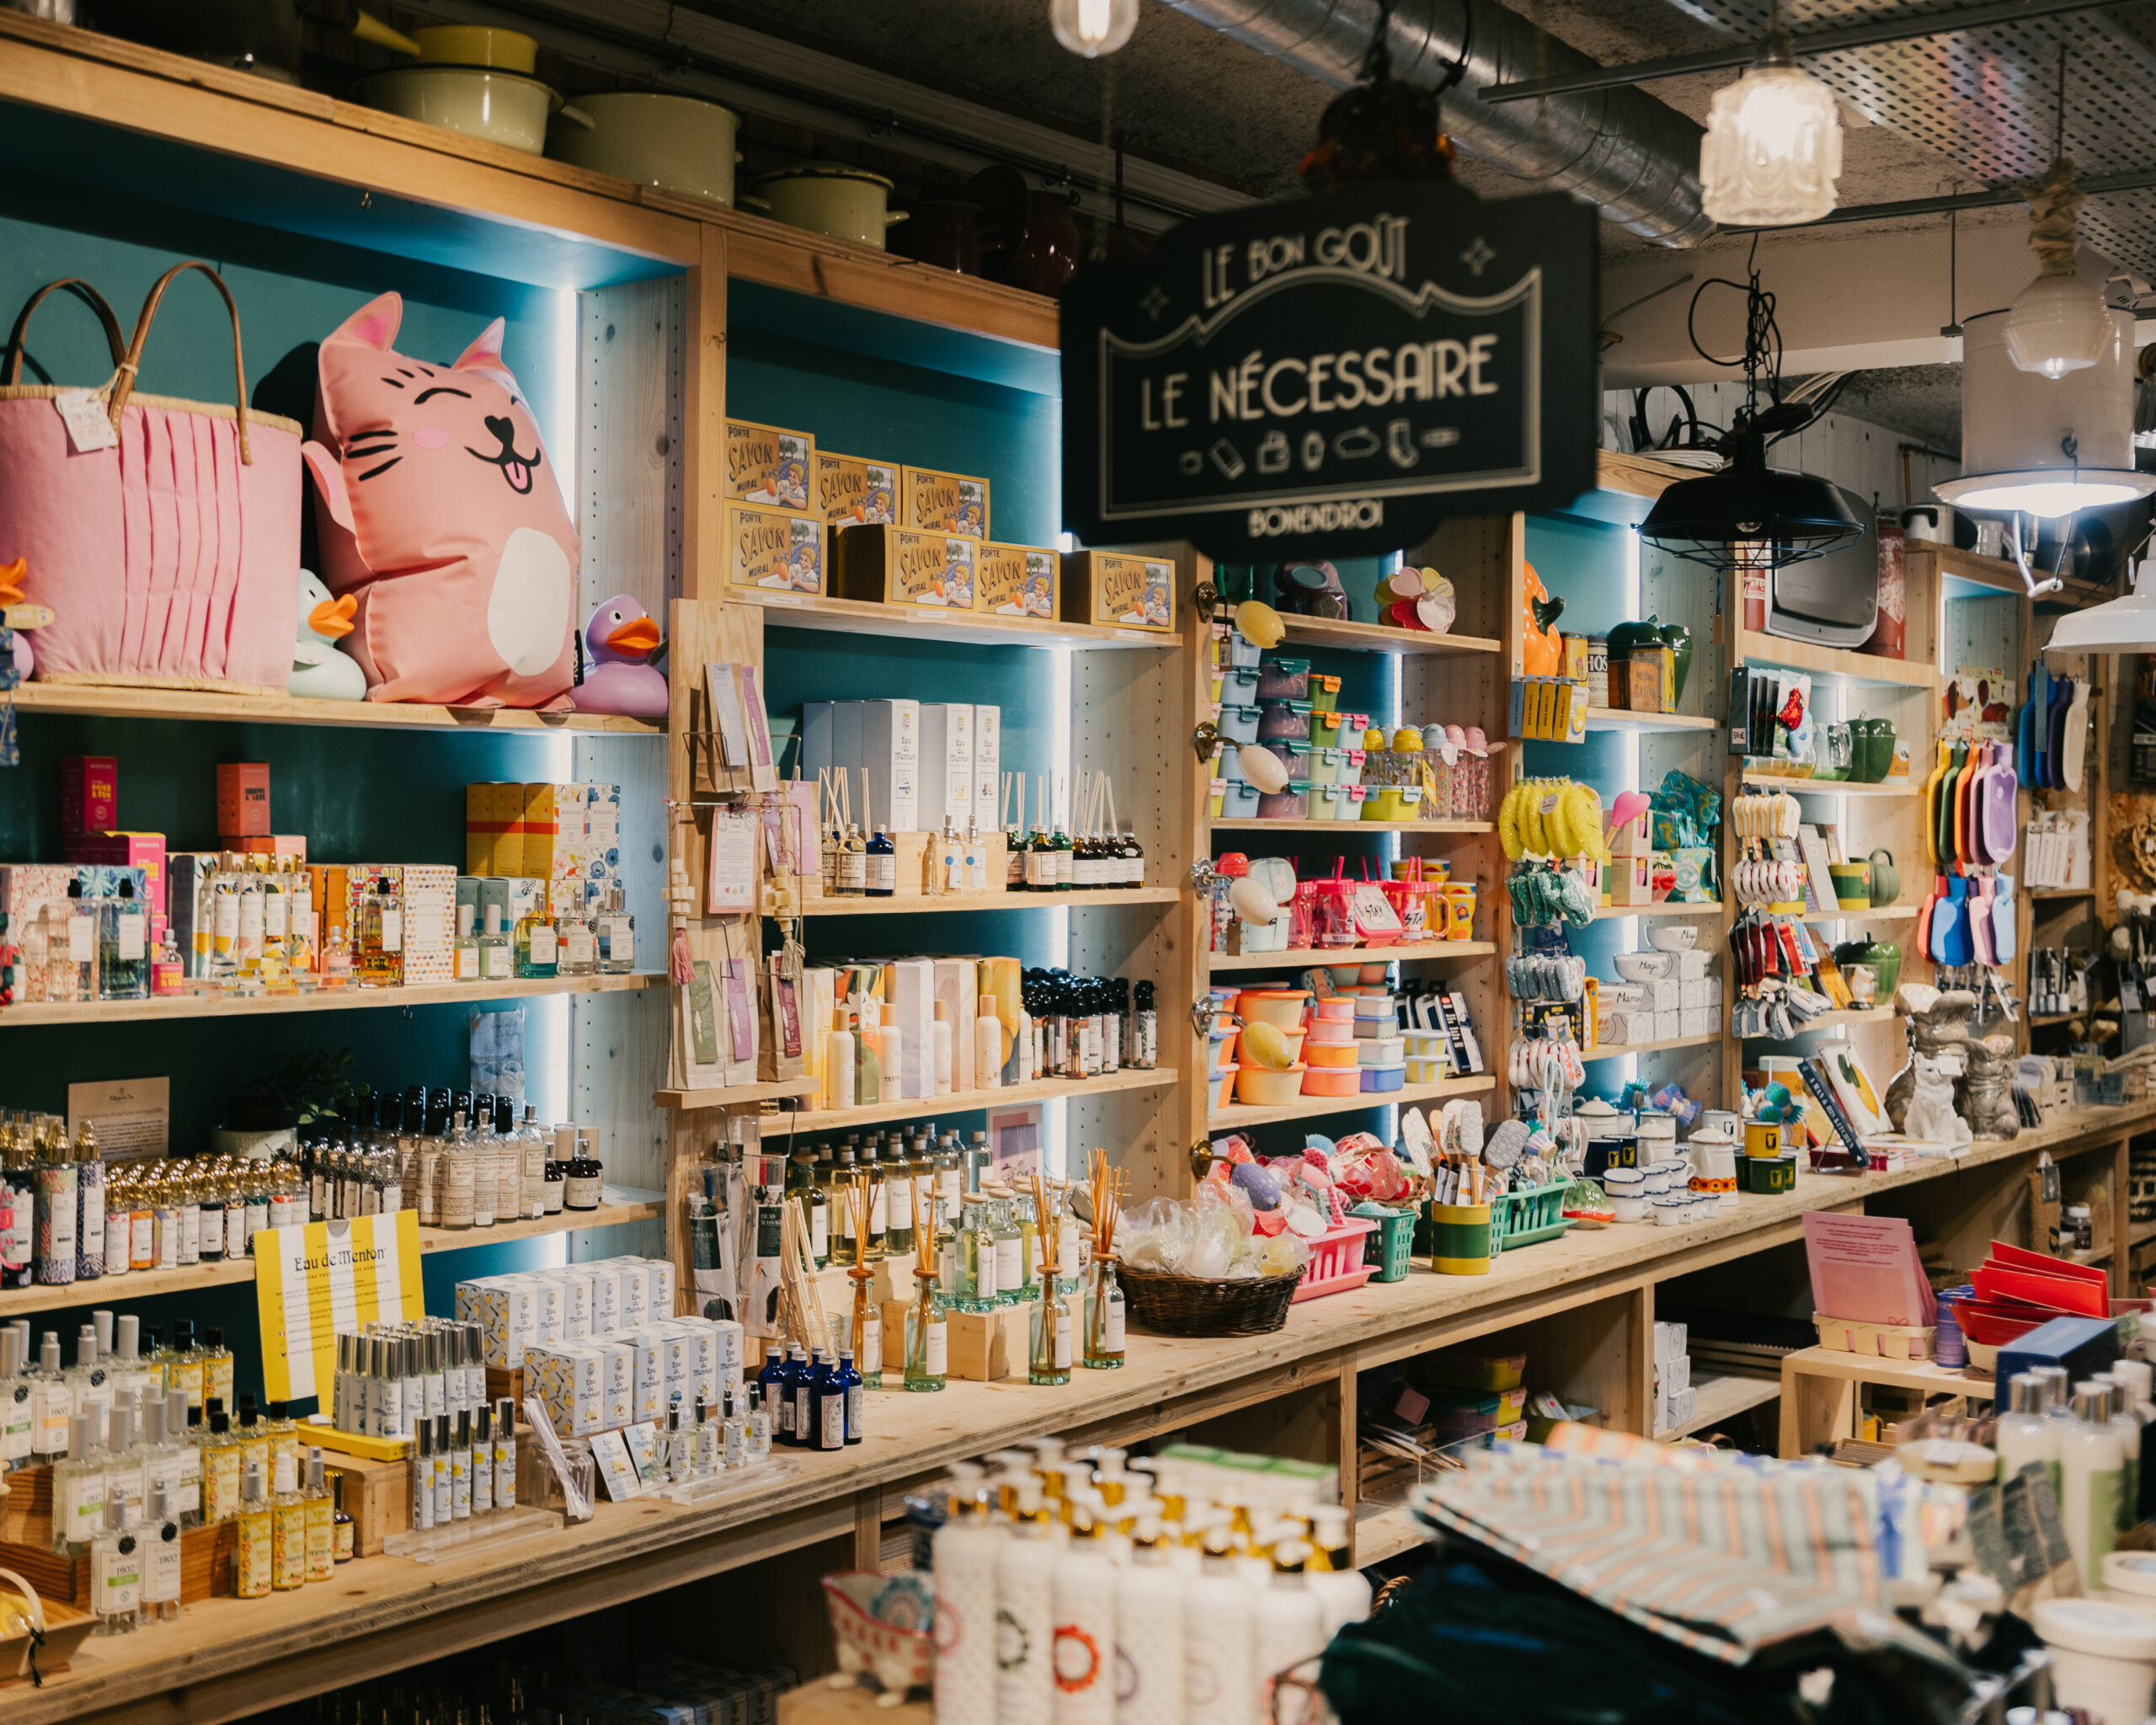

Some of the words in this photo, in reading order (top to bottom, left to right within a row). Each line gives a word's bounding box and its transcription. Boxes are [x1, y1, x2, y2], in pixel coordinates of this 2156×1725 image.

[1203, 244, 1235, 308] LE
[1248, 234, 1305, 282] BON
[1313, 212, 1411, 280] GOÛT
[1142, 372, 1188, 430] LE
[1209, 334, 1498, 422] NÉCESSAIRE
[728, 426, 750, 439] PORTE
[728, 441, 773, 482] SAVON
[820, 458, 841, 469] PORTE
[916, 473, 936, 485] PORTE
[736, 479, 758, 493] MURAL
[820, 472, 862, 510] SAVON
[916, 487, 954, 523] SAVON
[740, 511, 762, 524] PORTE
[828, 506, 847, 519] MURAL
[900, 533, 921, 546] PORTE
[740, 526, 785, 568] SAVON
[980, 547, 1001, 560] PORTE
[899, 547, 942, 586] SAVON
[1104, 558, 1123, 569] PORTE
[749, 564, 769, 579] MURAL
[979, 560, 1022, 598] SAVON
[907, 581, 927, 595] MURAL
[1104, 570, 1142, 607] SAVON
[987, 594, 1007, 607] MURAL
[1112, 602, 1129, 616] MURAL
[1364, 904, 1384, 919] STAY
[1812, 1083, 1824, 1098] MAN
[1826, 1105, 1835, 1119] HIS
[1834, 1118, 1855, 1149] KITCHEN
[295, 1257, 318, 1271] Eau
[322, 1252, 337, 1268] de
[339, 1247, 386, 1263] Menton
[693, 1368, 713, 1376] Menton
[720, 1361, 739, 1370] Menton
[640, 1380, 661, 1389] Menton
[665, 1374, 686, 1383] Menton
[579, 1391, 600, 1401] Menton
[607, 1386, 628, 1395] Menton
[51, 1407, 68, 1417] 1902
[181, 1467, 198, 1477] 1902
[86, 1493, 102, 1503] 1902
[158, 1553, 178, 1565] 1902
[116, 1563, 136, 1576] 1902
